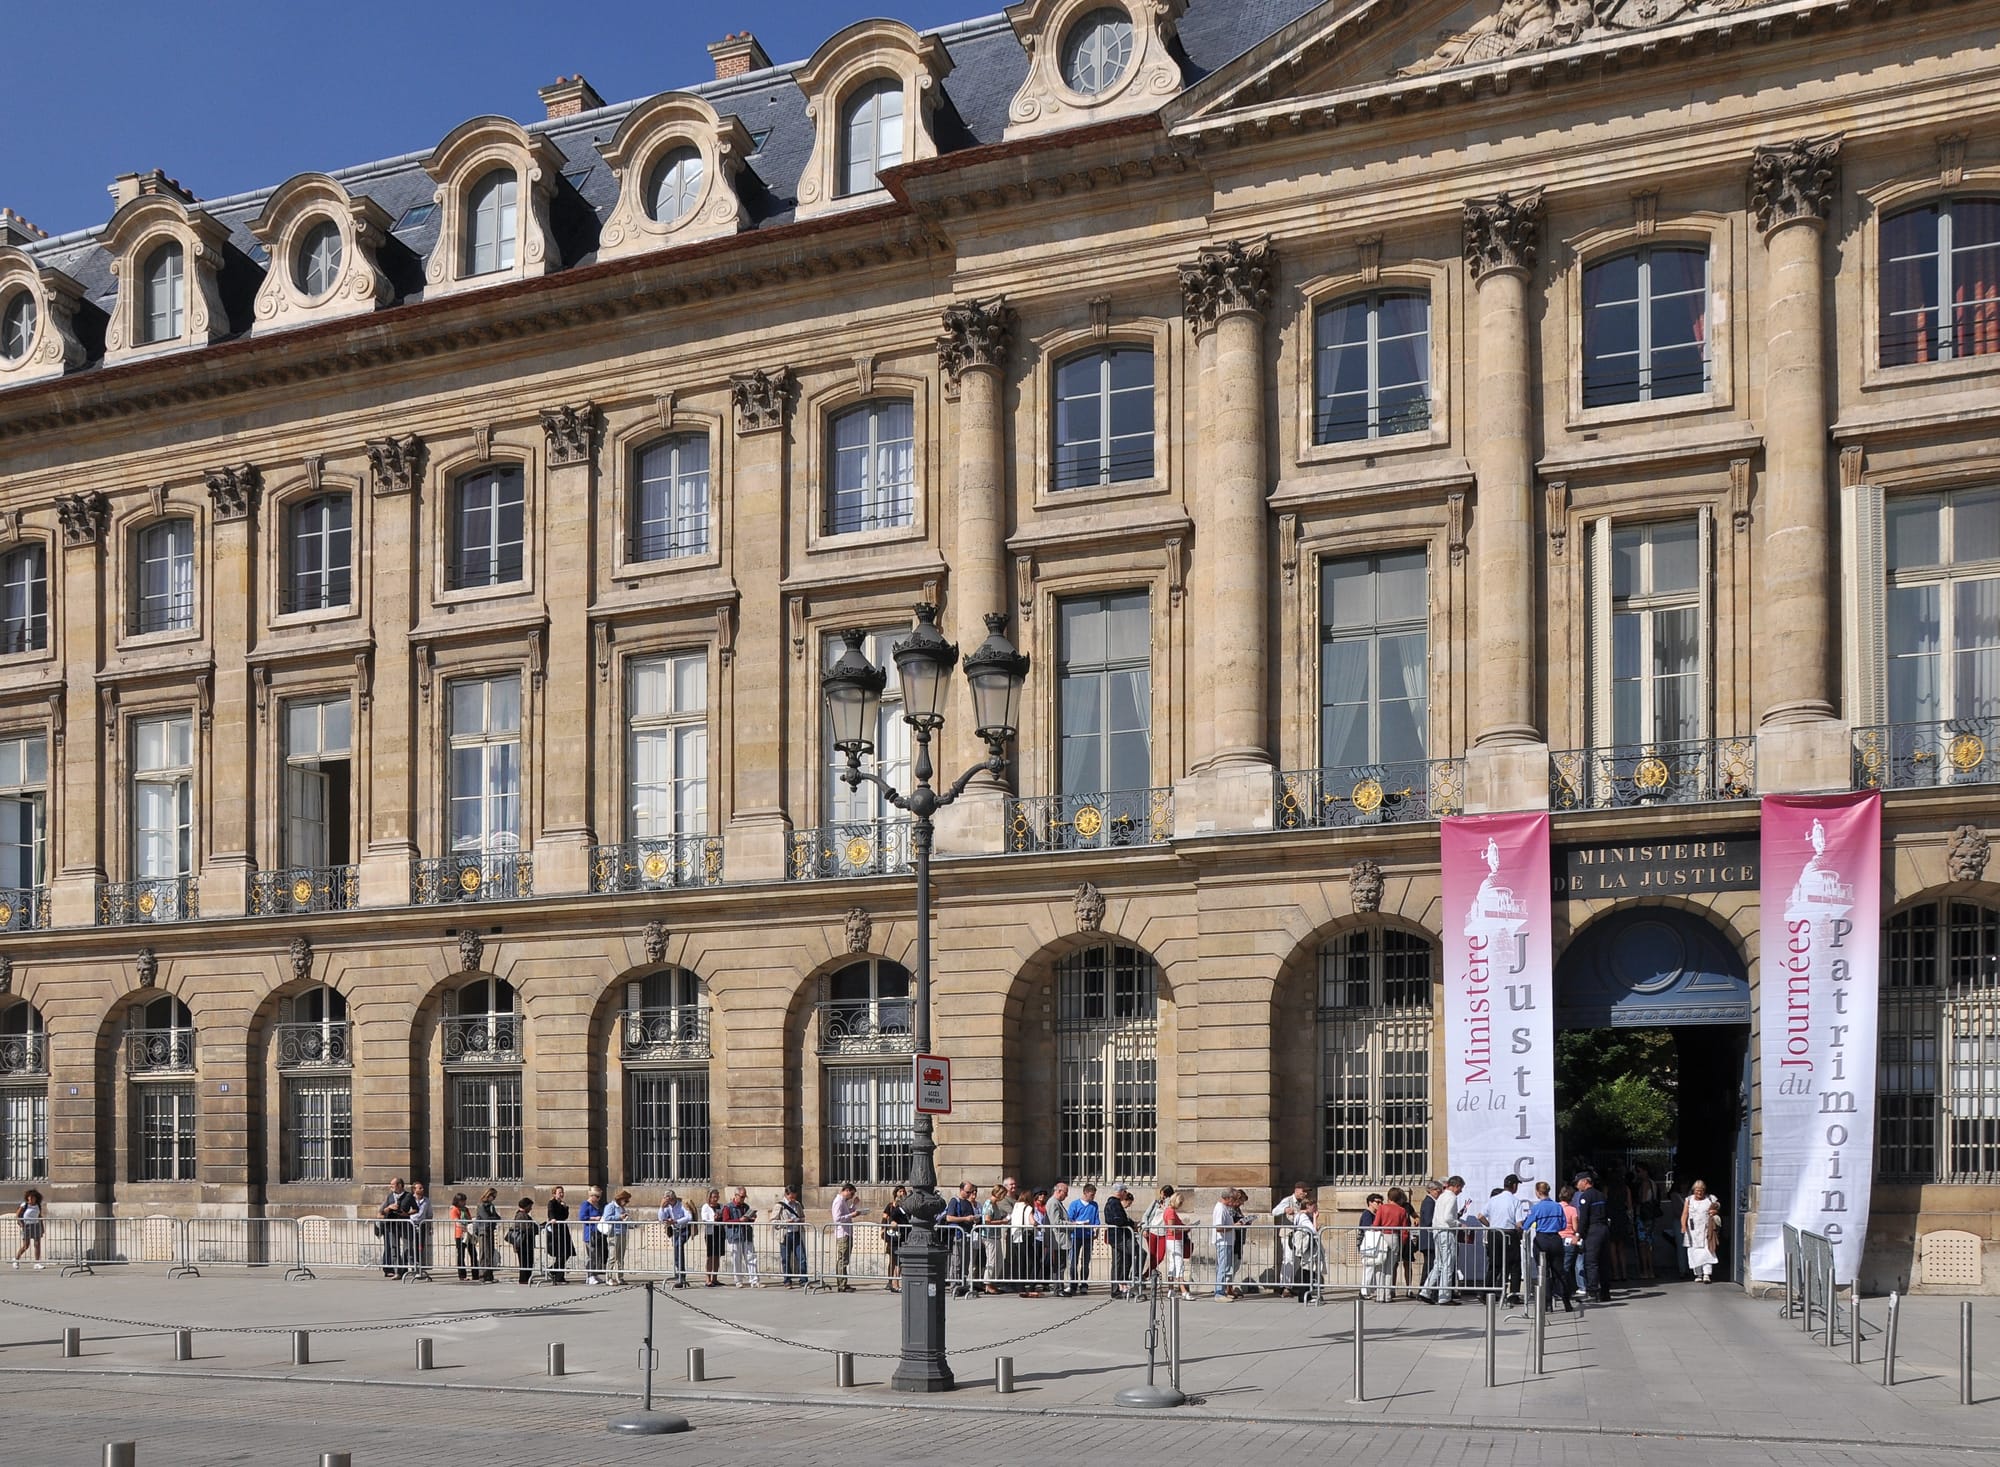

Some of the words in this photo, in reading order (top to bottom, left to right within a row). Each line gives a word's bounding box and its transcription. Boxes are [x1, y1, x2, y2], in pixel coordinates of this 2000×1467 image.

[1554, 875, 1583, 891] DE
[1600, 873, 1628, 889] LA
[1640, 865, 1754, 886] JUSTICE
[1579, 841, 1726, 864] MINISTERE
[1461, 934, 1491, 1085] Ministère
[1779, 919, 1814, 1072] Journées
[1456, 1090, 1479, 1111] de
[1487, 1089, 1506, 1110] la
[1778, 1072, 1812, 1095] du
[1817, 918, 1857, 1245] Patrimoine
